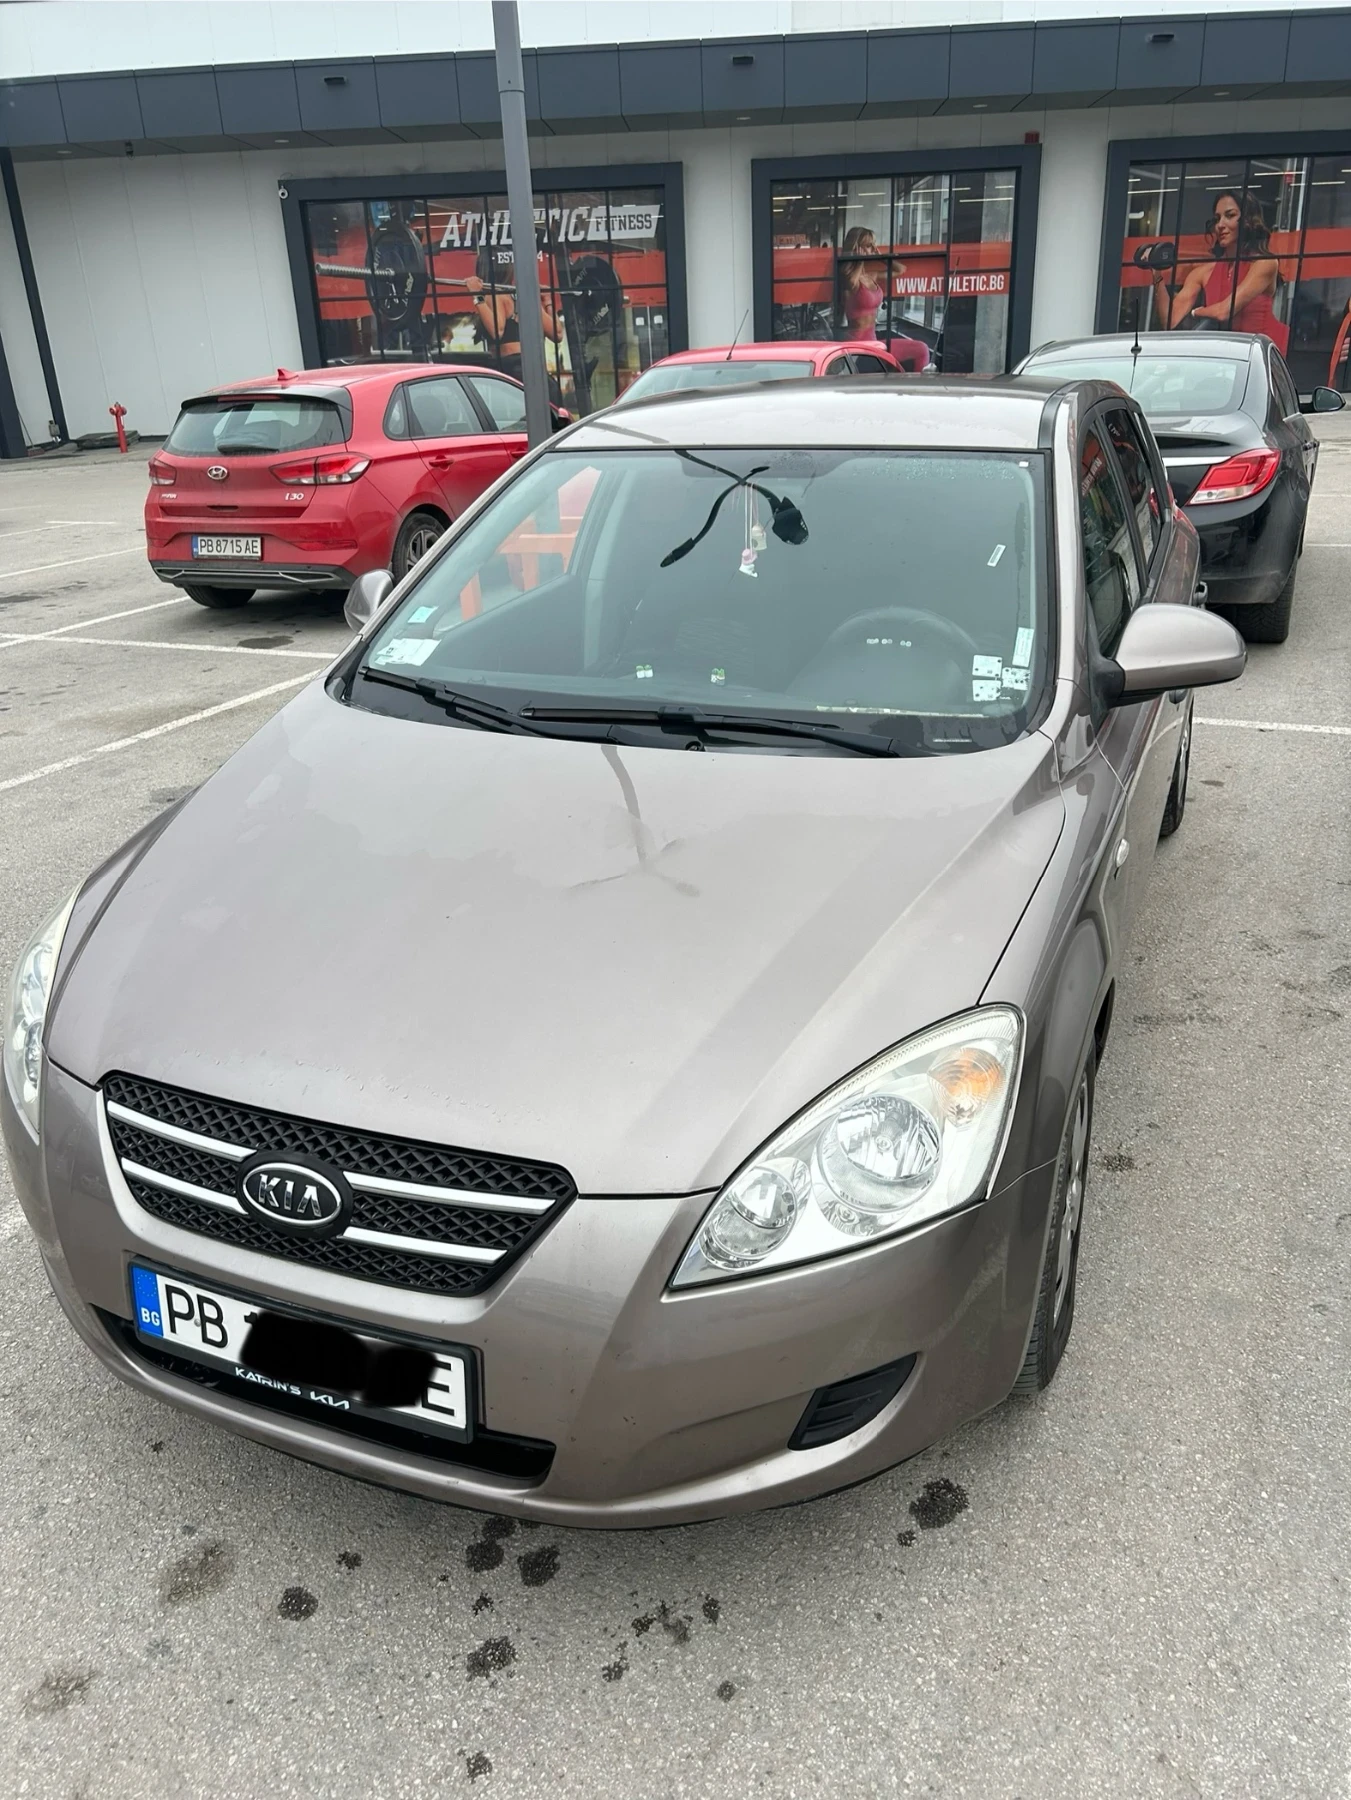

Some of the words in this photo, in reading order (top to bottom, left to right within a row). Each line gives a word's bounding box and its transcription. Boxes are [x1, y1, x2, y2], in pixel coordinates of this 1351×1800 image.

[440, 207, 592, 248] ATHLTIC
[595, 213, 653, 232] FITNESS
[257, 1173, 323, 1217] KIA
[140, 1306, 160, 1326] BG
[165, 1283, 229, 1349] PB
[235, 1366, 301, 1396] KATRIN'S
